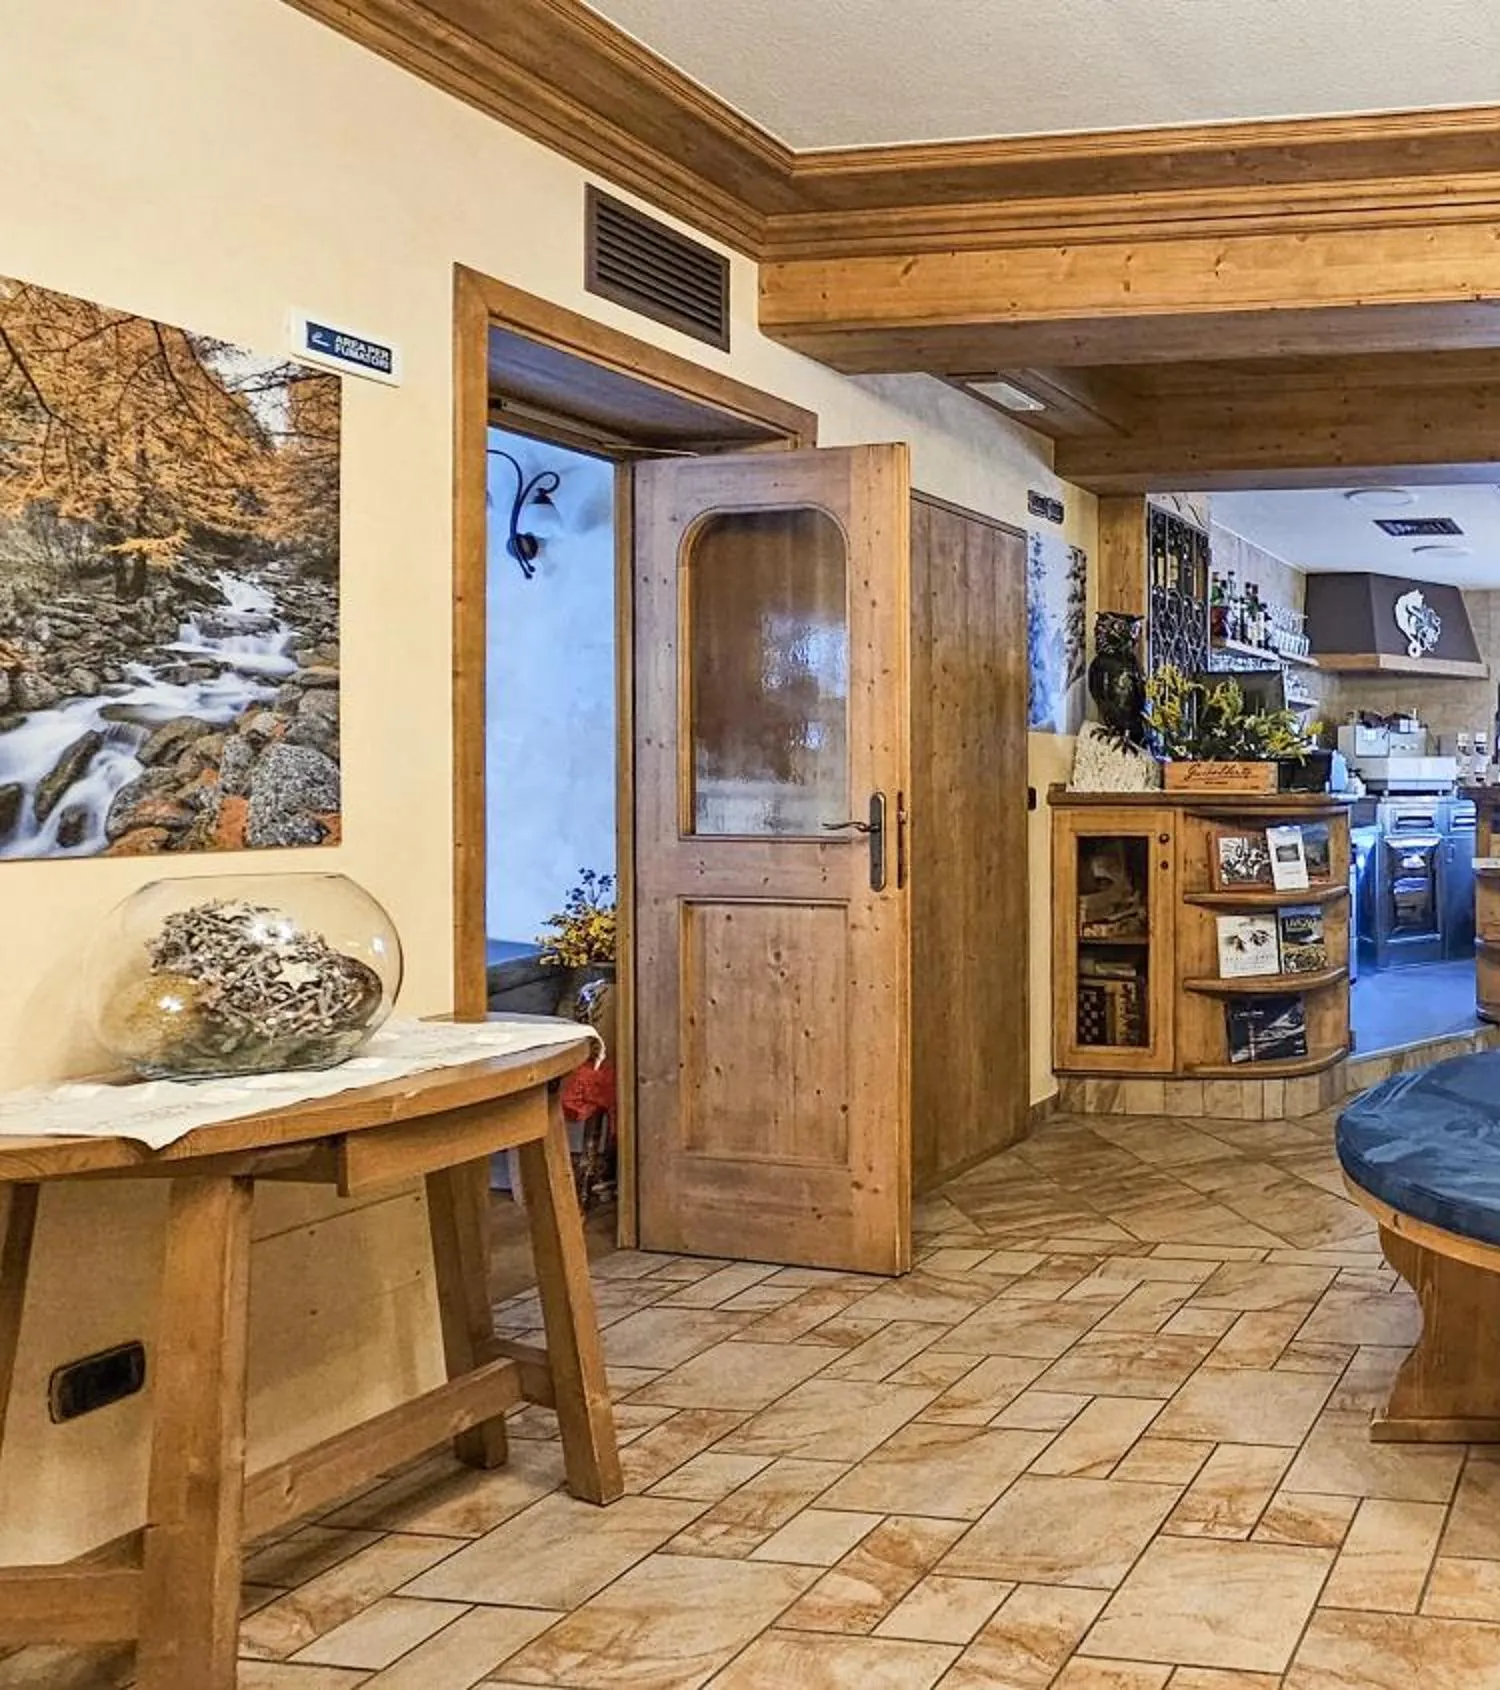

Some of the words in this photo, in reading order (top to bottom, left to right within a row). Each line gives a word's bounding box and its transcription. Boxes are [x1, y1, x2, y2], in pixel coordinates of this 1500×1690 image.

[334, 345, 389, 369] FUMATORI
[335, 335, 367, 354] AREA
[368, 345, 389, 361] PER
